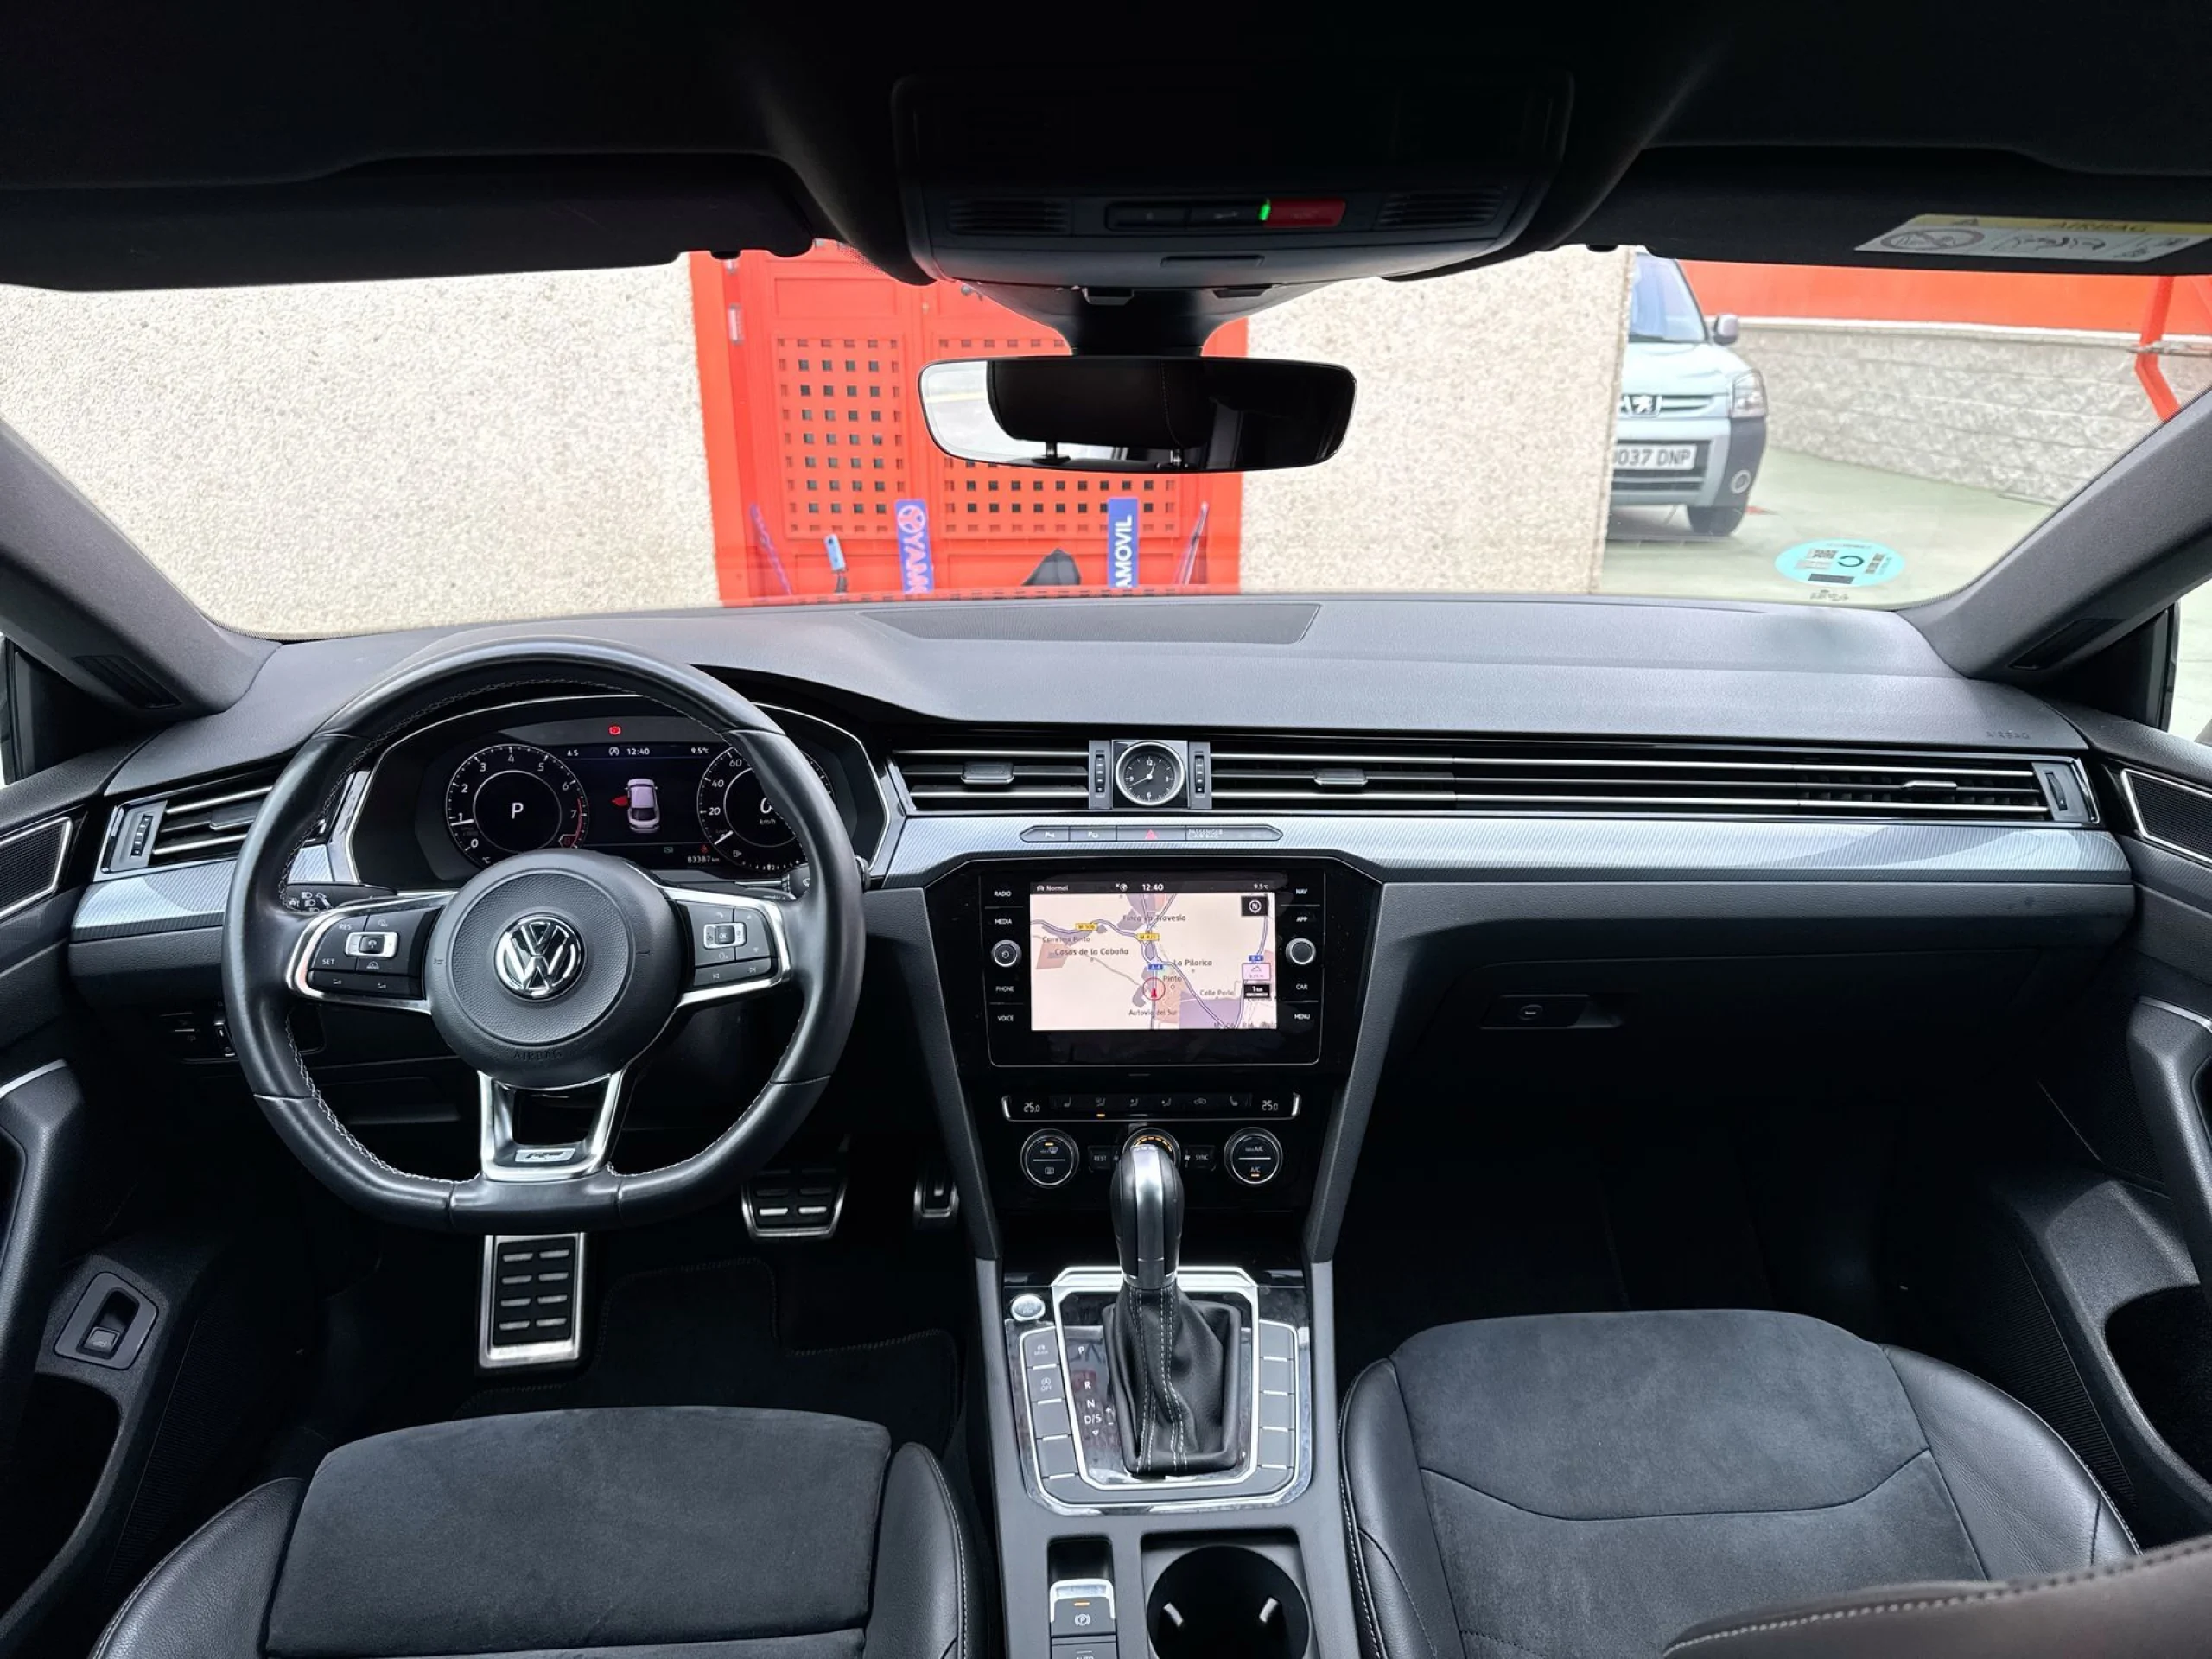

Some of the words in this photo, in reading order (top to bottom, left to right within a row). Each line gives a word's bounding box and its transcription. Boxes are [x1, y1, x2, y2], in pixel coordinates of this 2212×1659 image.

[1658, 449, 1691, 466] DNP
[1115, 515, 1133, 588] AMOVIL
[626, 747, 650, 756] 12:40
[507, 754, 515, 764] 4
[728, 759, 742, 768] 60
[480, 762, 487, 772] 3
[537, 762, 545, 772] 5
[461, 784, 468, 793] 2
[562, 781, 570, 791] 6
[711, 779, 725, 788] 40
[511, 802, 524, 819] P
[570, 810, 576, 819] 7
[708, 807, 721, 817] 20
[470, 838, 479, 848] 0
[513, 1050, 563, 1061] AIRBAG
[1078, 1346, 1085, 1355] P
[1084, 1380, 1091, 1389] R
[1086, 1399, 1095, 1408] N
[1084, 1414, 1102, 1425] D/S
